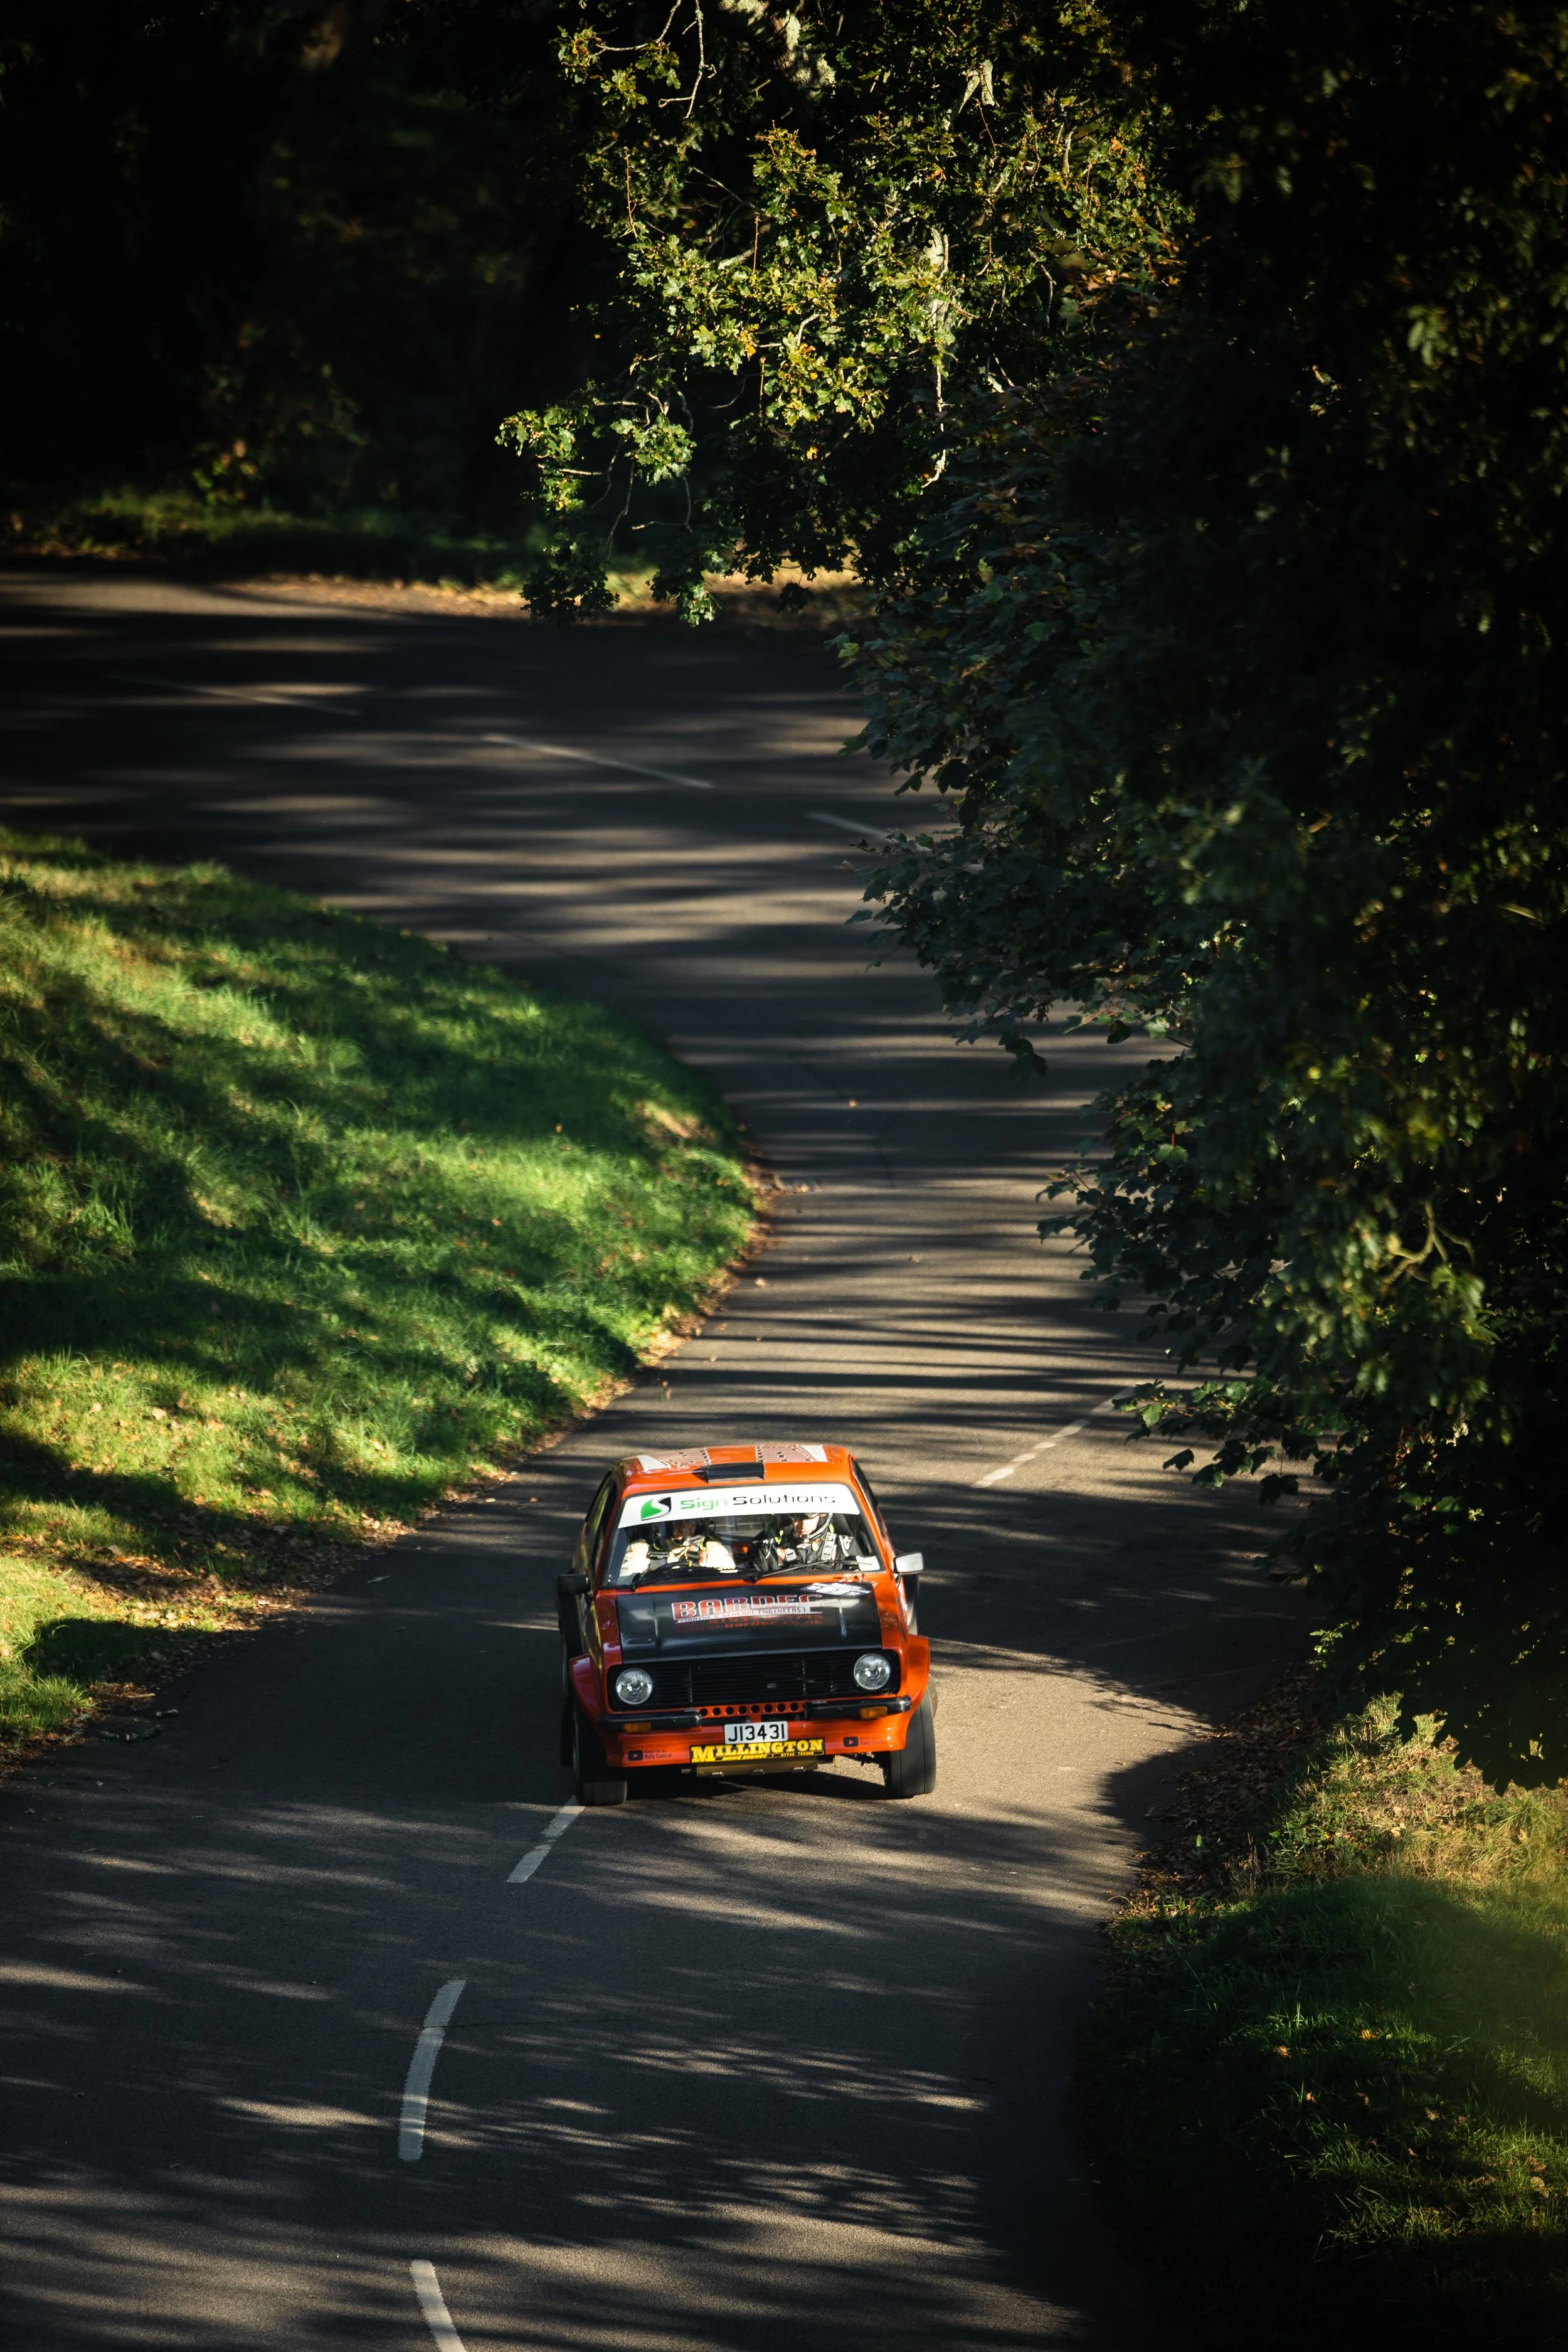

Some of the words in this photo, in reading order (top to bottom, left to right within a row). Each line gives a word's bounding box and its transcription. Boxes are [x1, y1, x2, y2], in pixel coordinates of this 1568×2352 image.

[679, 1498, 728, 1510] Sign
[733, 1493, 835, 1505] Solutions
[671, 1594, 823, 1621] BARDEC
[691, 1739, 824, 1763] MILLINGTON
